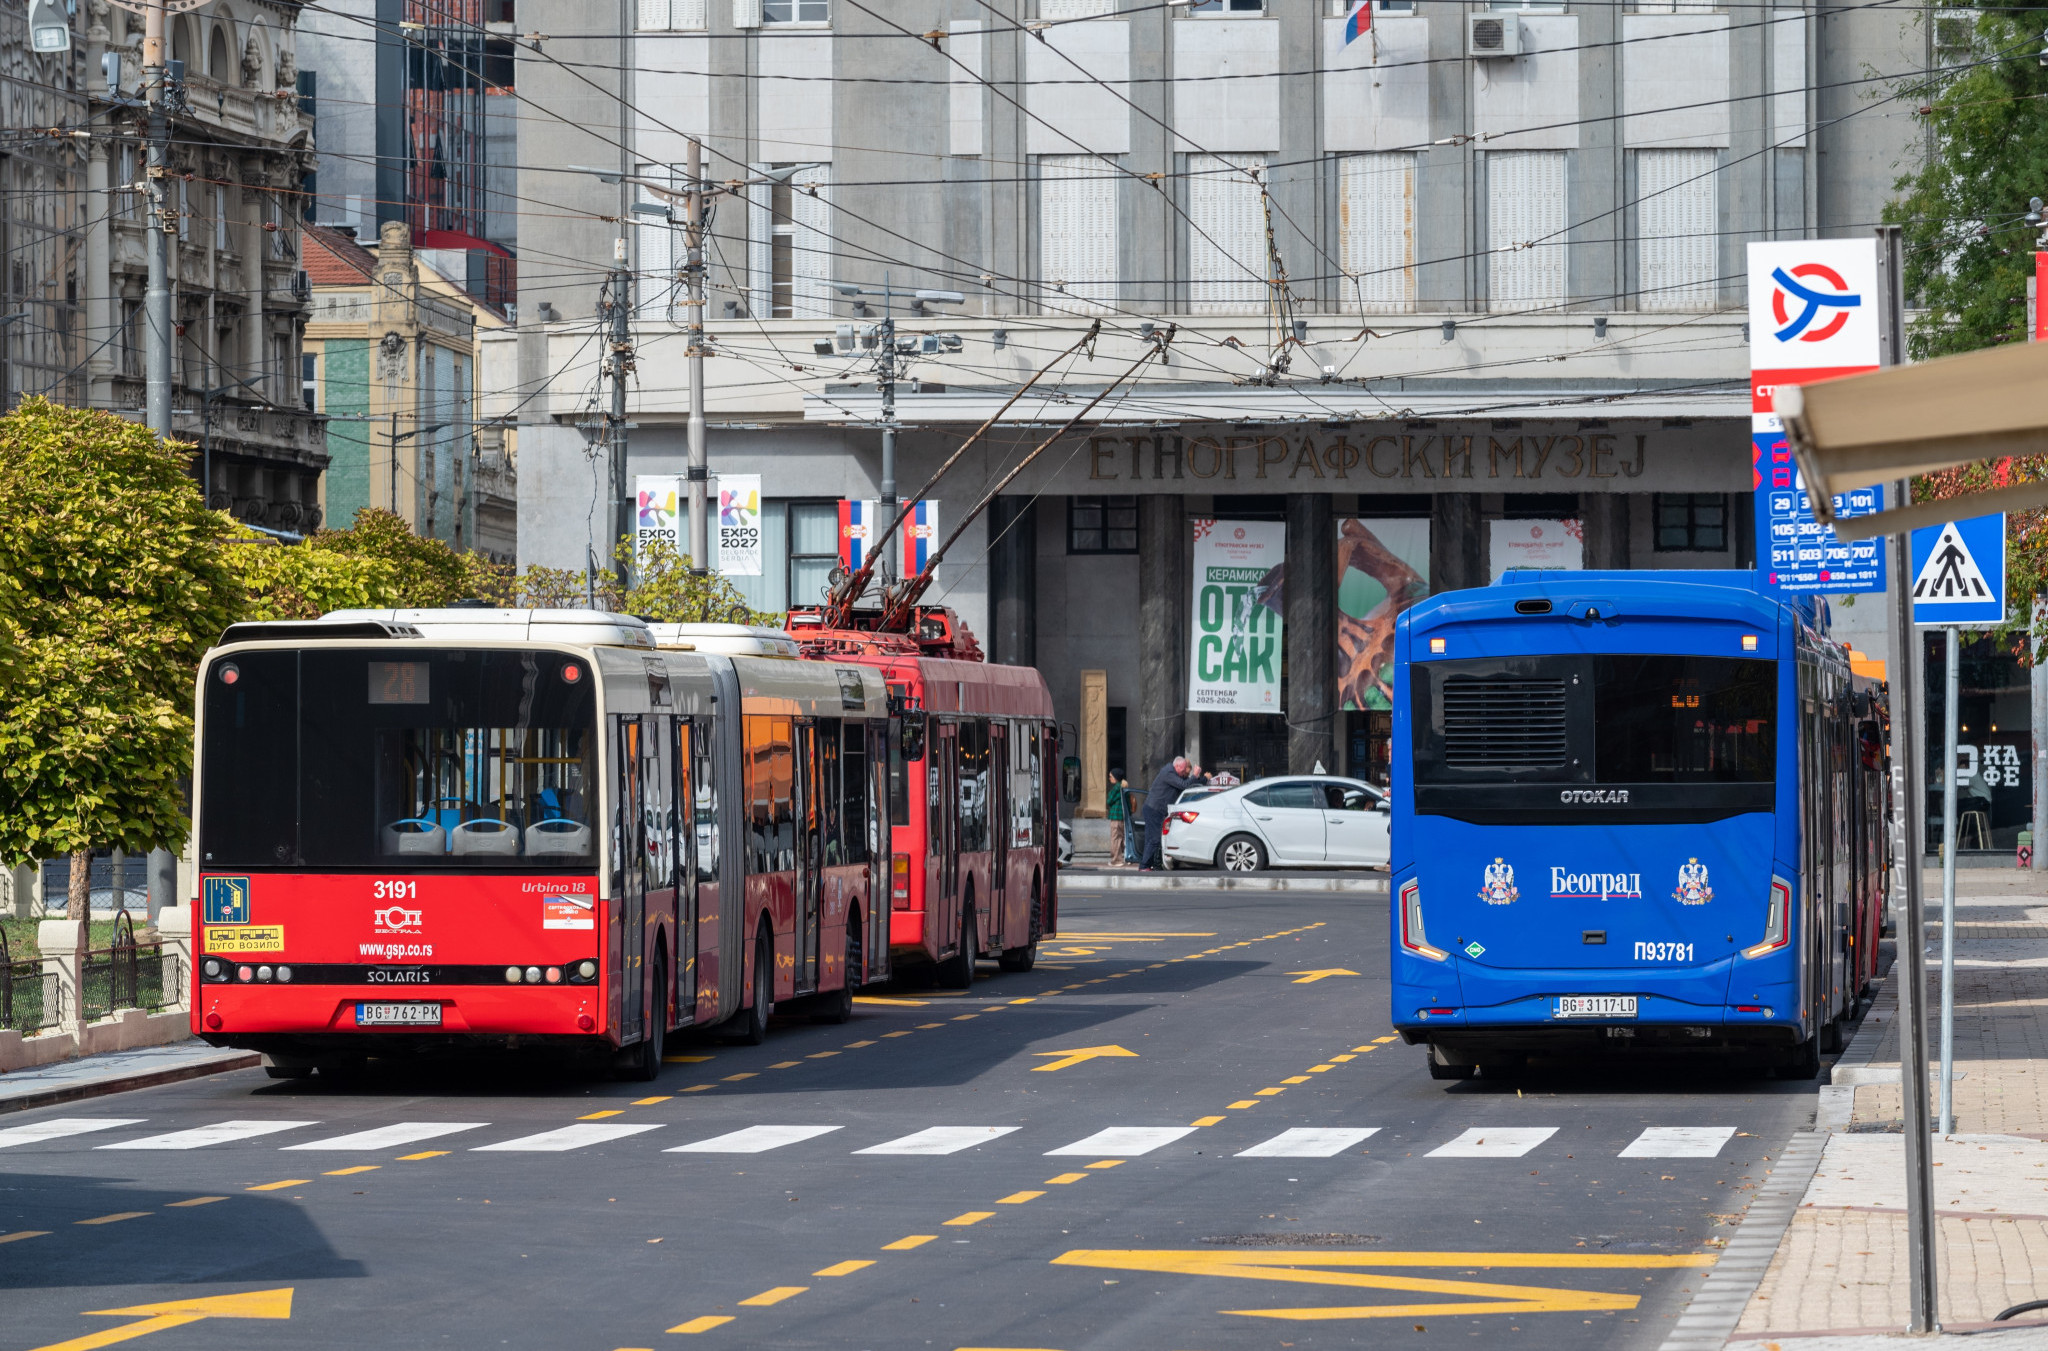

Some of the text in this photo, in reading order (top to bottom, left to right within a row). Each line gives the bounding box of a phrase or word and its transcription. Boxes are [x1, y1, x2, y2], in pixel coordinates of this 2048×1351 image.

[1089, 434, 1647, 480] ЕТНОГРАФСКИ МУЗЕЈ
[1774, 498, 1791, 510] 29
[1851, 496, 1872, 507] 101
[639, 529, 676, 539] EXPO
[721, 528, 758, 538] EXPO
[1772, 524, 1795, 536] 105
[1798, 523, 1822, 534] 302
[722, 538, 758, 548] 2027
[1772, 550, 1794, 562] 511
[1798, 549, 1822, 560] 603
[1825, 548, 1848, 560] 706
[1852, 546, 1876, 558] 707
[1208, 568, 1265, 581] КЕРАМИКА
[1198, 634, 1274, 684] САК
[1196, 689, 1238, 697] СЕПТЕМБАР
[1984, 745, 2021, 766] КА
[1983, 766, 2020, 787] ФЕ
[1560, 790, 1630, 804] OTOKAR
[522, 882, 586, 893] Urbino 18
[1550, 866, 1642, 901] Београд
[374, 881, 416, 899] 3191
[374, 906, 422, 929] ГСП
[209, 941, 280, 951] ДУГО ВОЗИЛО
[360, 944, 432, 960] www.gsp.co.rs
[1634, 942, 1694, 962] П93781
[367, 971, 430, 982] SOLARIS
[1562, 1000, 1576, 1012] BG
[366, 1006, 382, 1020] BG
